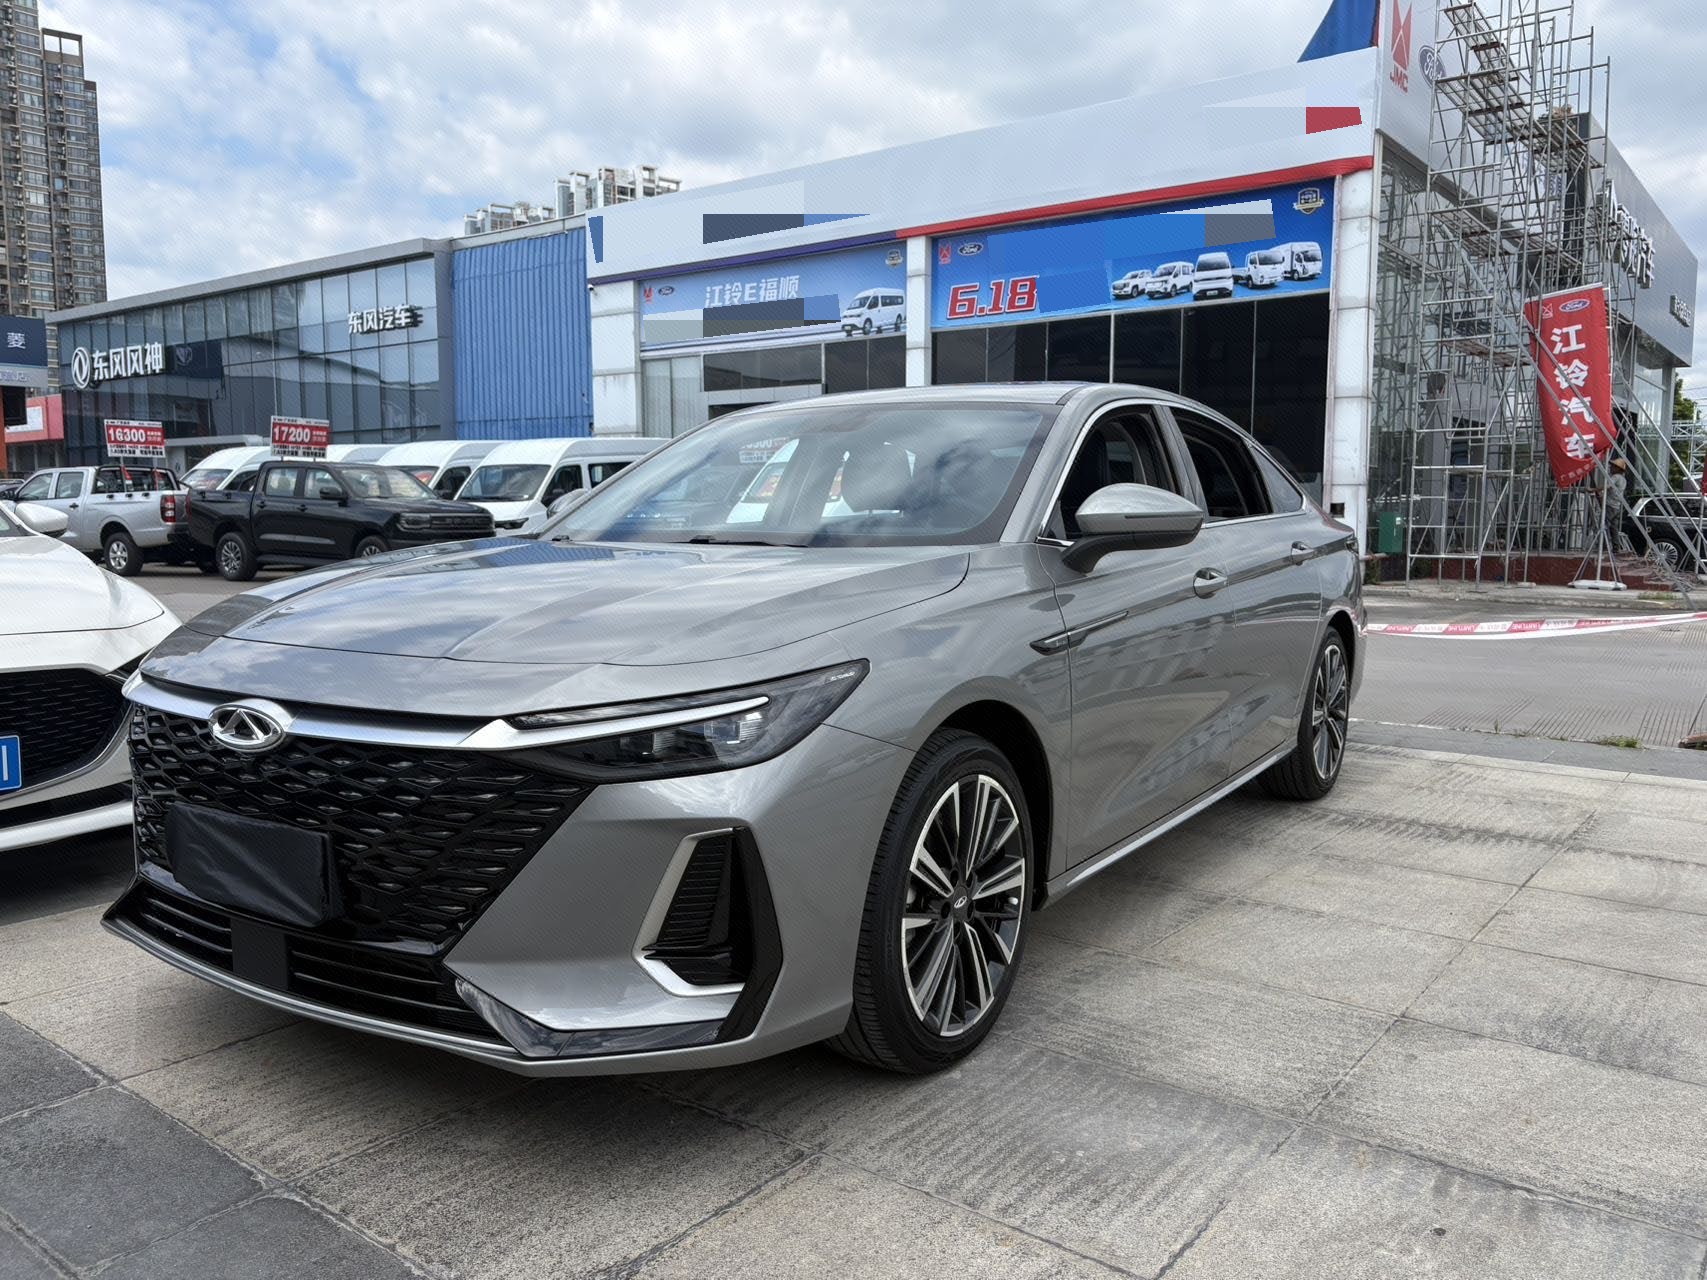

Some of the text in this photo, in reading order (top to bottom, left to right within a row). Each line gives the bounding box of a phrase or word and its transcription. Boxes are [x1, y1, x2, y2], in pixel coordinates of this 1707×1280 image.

[1390, 64, 1408, 93] JMC
[705, 275, 800, 308] 江铃E福顺
[947, 275, 1038, 319] 6.18
[347, 304, 411, 334] 东风汽车
[92, 342, 163, 380] 东风风神
[108, 427, 146, 442] 16300
[274, 425, 311, 443] 17200
